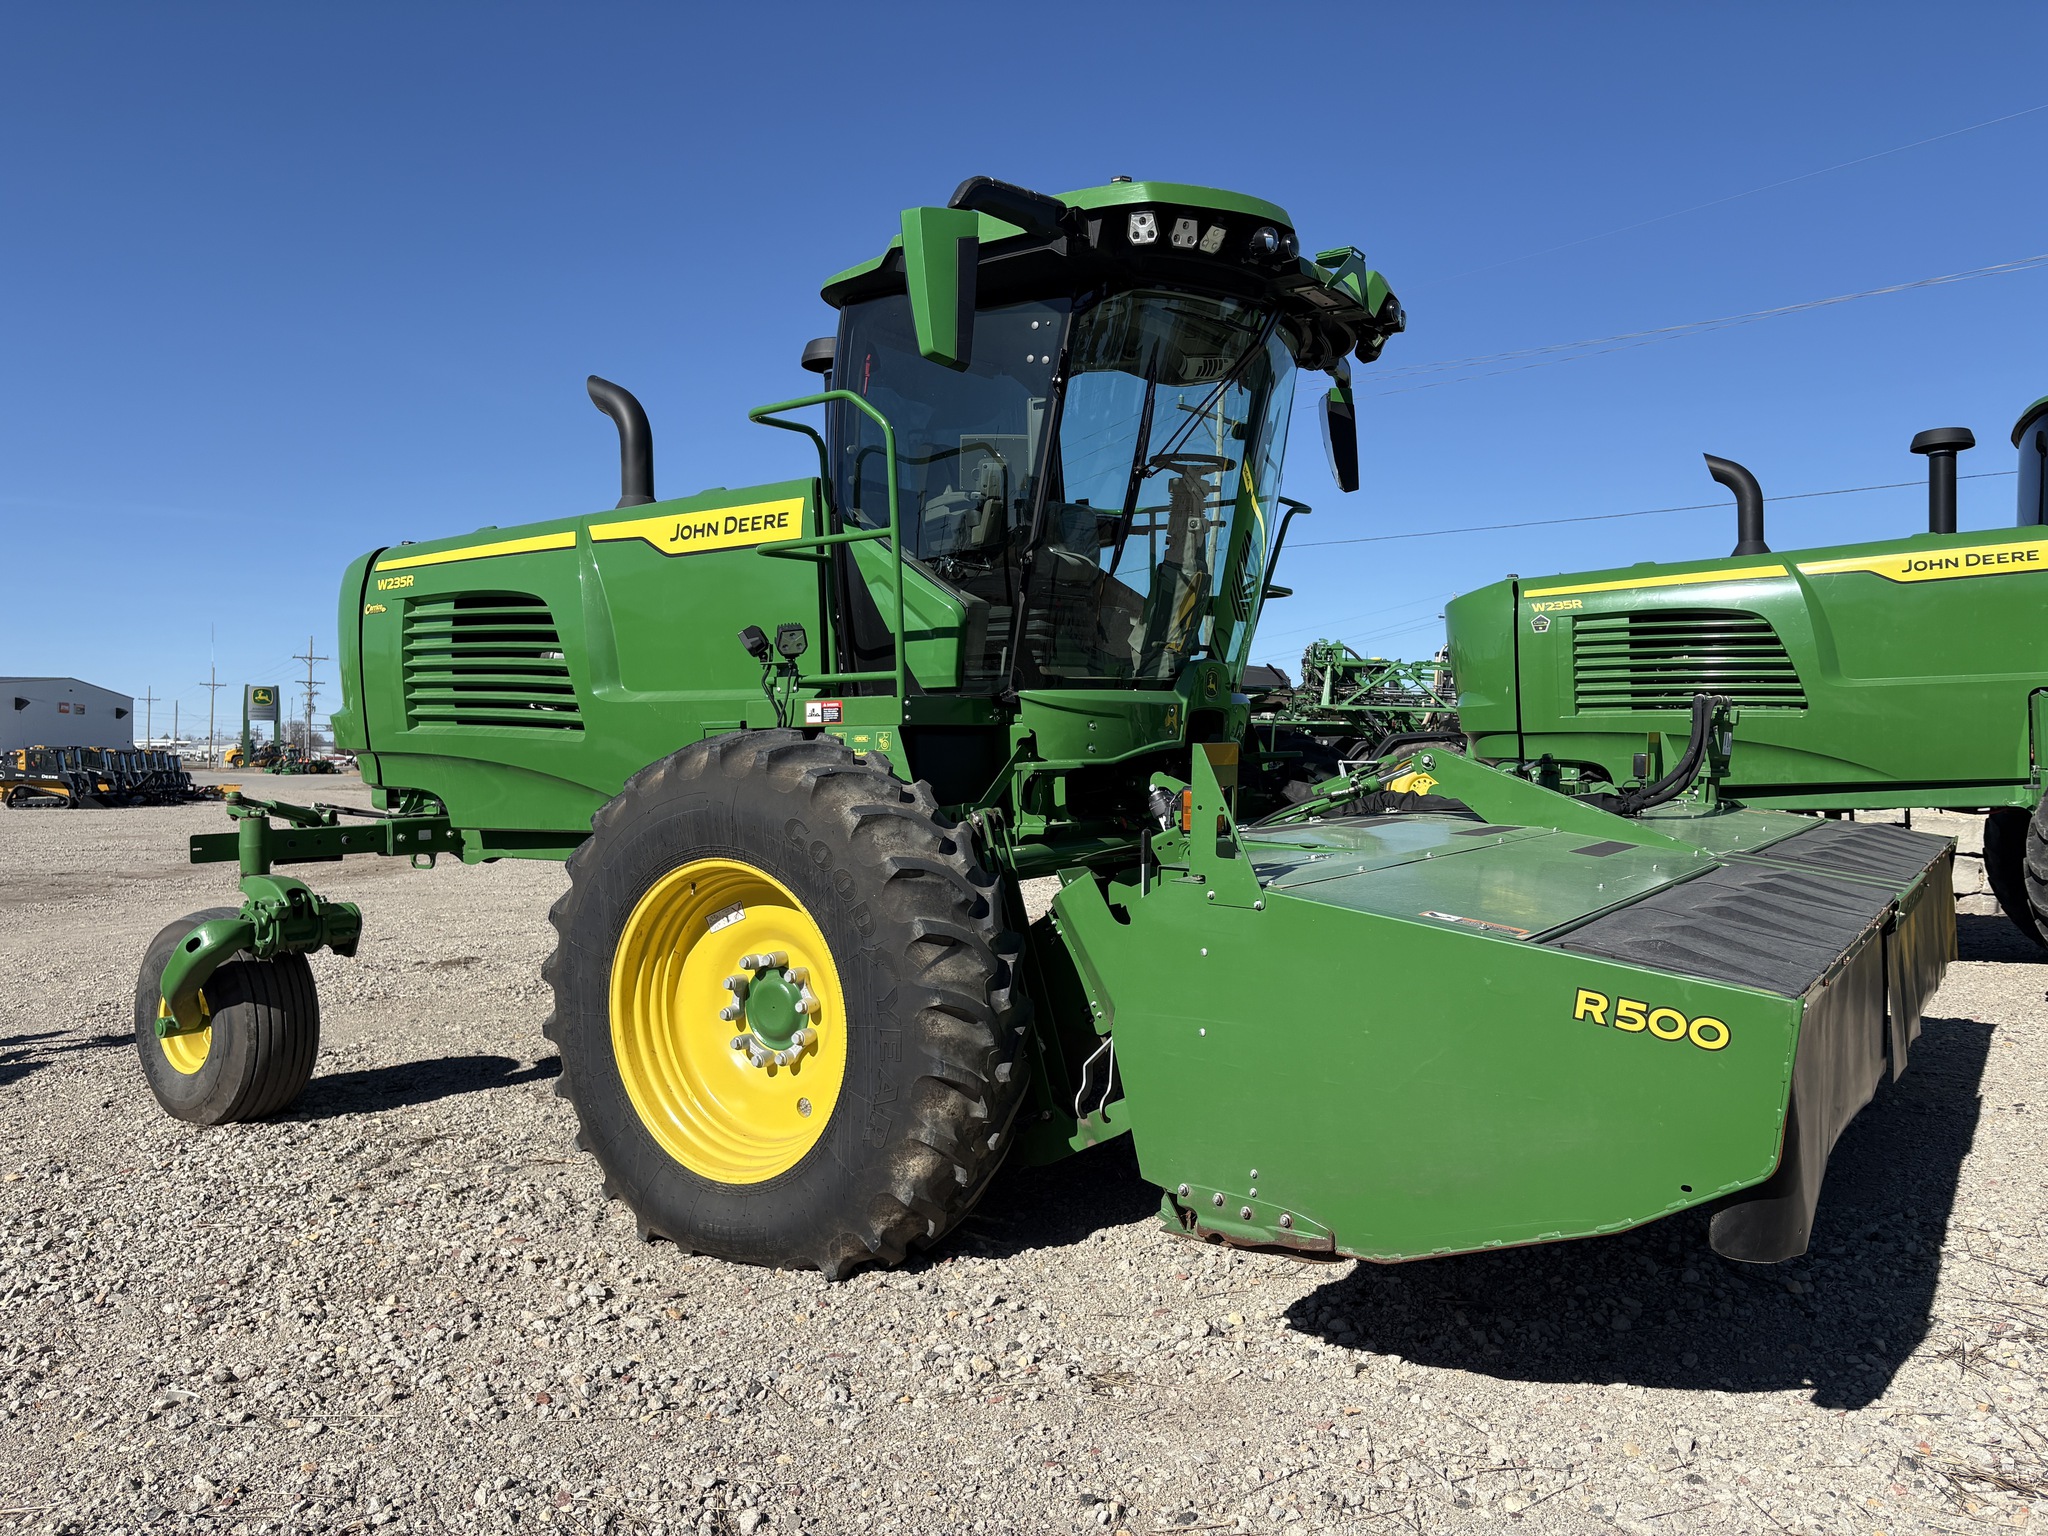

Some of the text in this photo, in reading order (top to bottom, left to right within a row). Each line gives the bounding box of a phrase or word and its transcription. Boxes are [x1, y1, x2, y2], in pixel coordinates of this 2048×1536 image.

[670, 512, 789, 542] JOHN DEERE
[1901, 550, 2040, 573] JOHN DEERE
[377, 575, 415, 591] W235R
[1531, 599, 1583, 613] W235R
